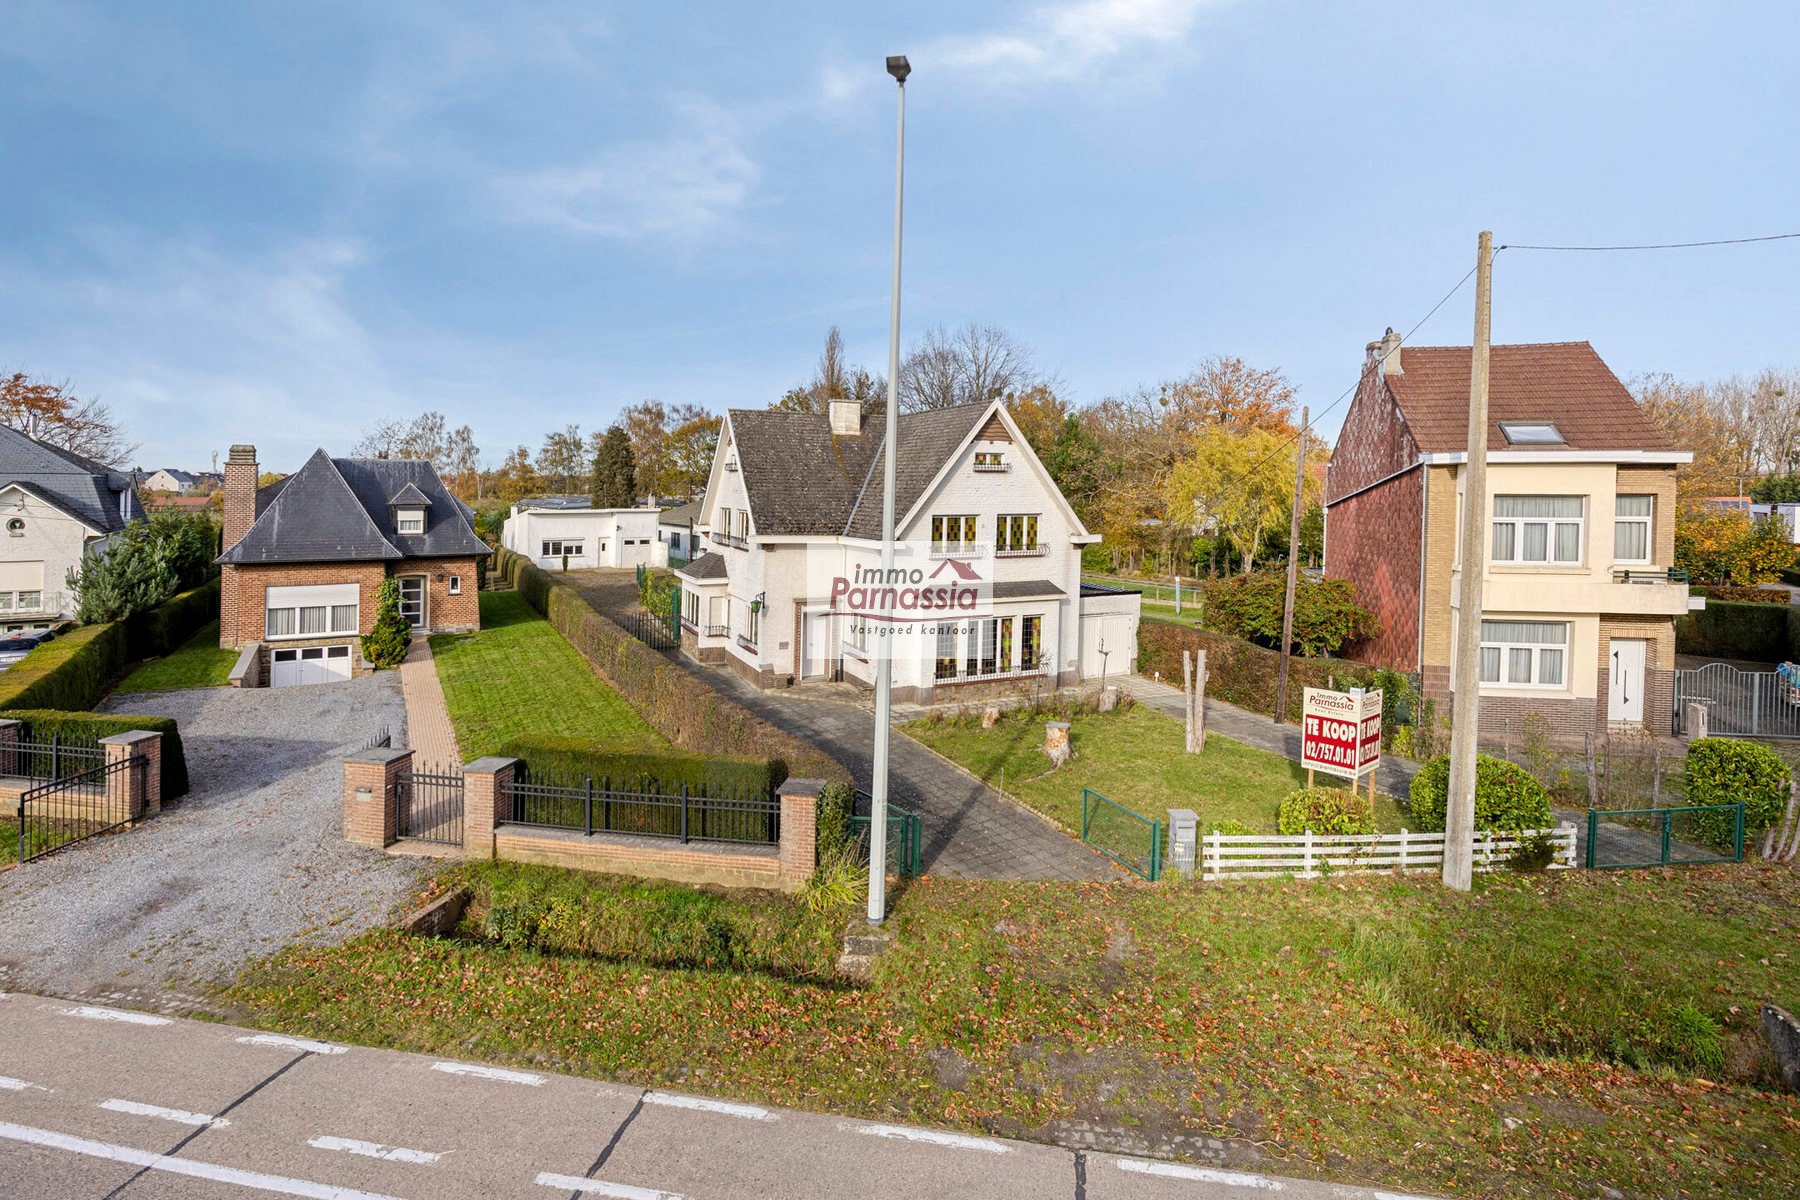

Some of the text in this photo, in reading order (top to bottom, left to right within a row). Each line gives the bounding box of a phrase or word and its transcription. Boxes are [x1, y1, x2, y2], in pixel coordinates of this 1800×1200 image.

[1309, 695, 1354, 711] Parnassia
[1306, 718, 1356, 743] TE KOOP
[1305, 740, 1355, 766] 02/757.01.01
